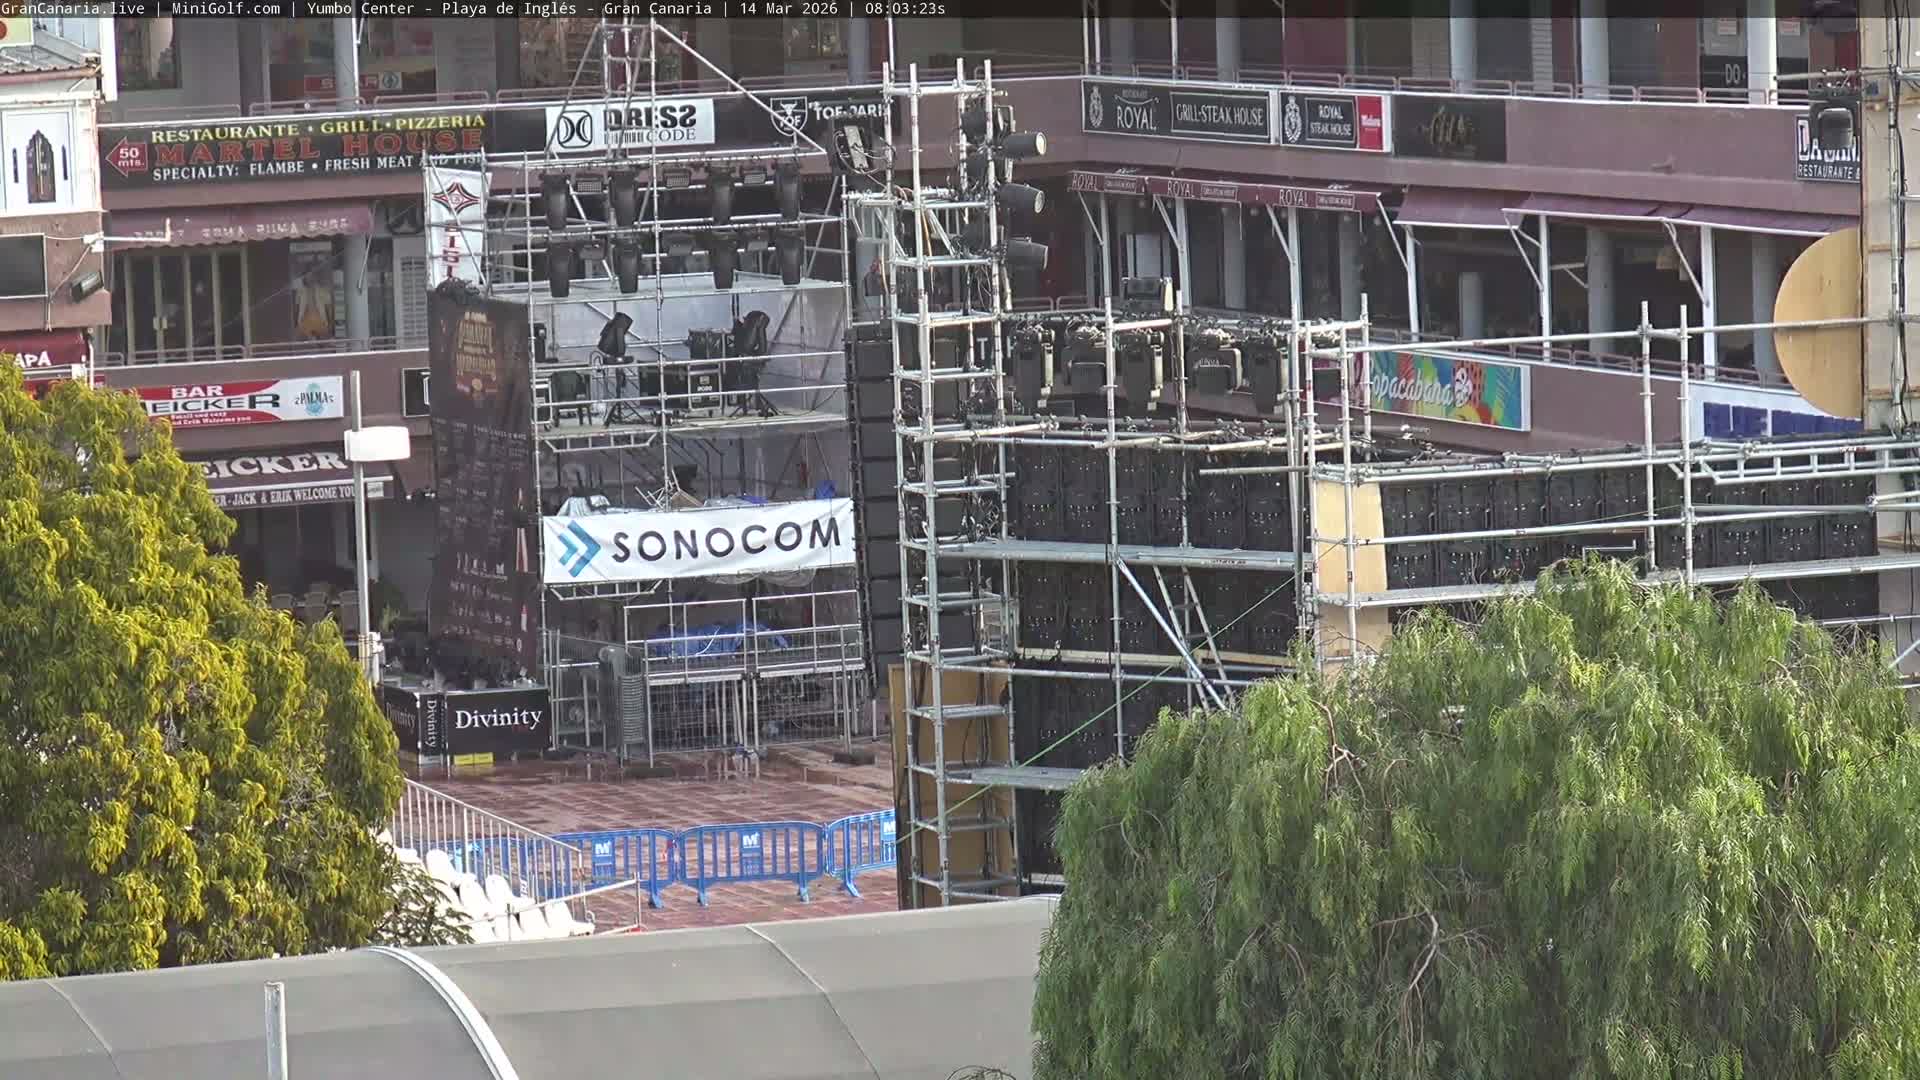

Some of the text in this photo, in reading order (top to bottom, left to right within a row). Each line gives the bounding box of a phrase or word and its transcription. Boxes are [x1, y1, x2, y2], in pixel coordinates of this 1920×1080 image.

[1116, 105, 1157, 131] ROYAL
[1234, 107, 1265, 127] HOUSE
[1318, 104, 1344, 120] ROYAL
[152, 114, 486, 144] RESTAURANTE GRILL PIZZERIA
[646, 128, 696, 143] CODE
[1310, 121, 1352, 136] STEAK HOUSE
[119, 148, 140, 159] 50
[155, 128, 482, 166] MARTEL HOUSE
[117, 157, 145, 167] mts.
[153, 165, 239, 181] SPECIALTY:
[250, 161, 304, 176] FLAMBE
[325, 157, 370, 171] FRESH
[377, 156, 413, 169] MEAT
[1798, 164, 1854, 179] RESTAURANTE
[1072, 173, 1099, 191] ROYAL
[1166, 180, 1195, 198] ROYAL
[1280, 188, 1309, 207] ROYAL
[170, 385, 224, 399] BAR
[232, 491, 257, 505] JACK
[270, 489, 295, 503] ERIK
[295, 486, 338, 502] WELCOME
[611, 516, 841, 563] SONOCOM
[425, 699, 438, 748] Divinity
[455, 707, 543, 730] Divinity
